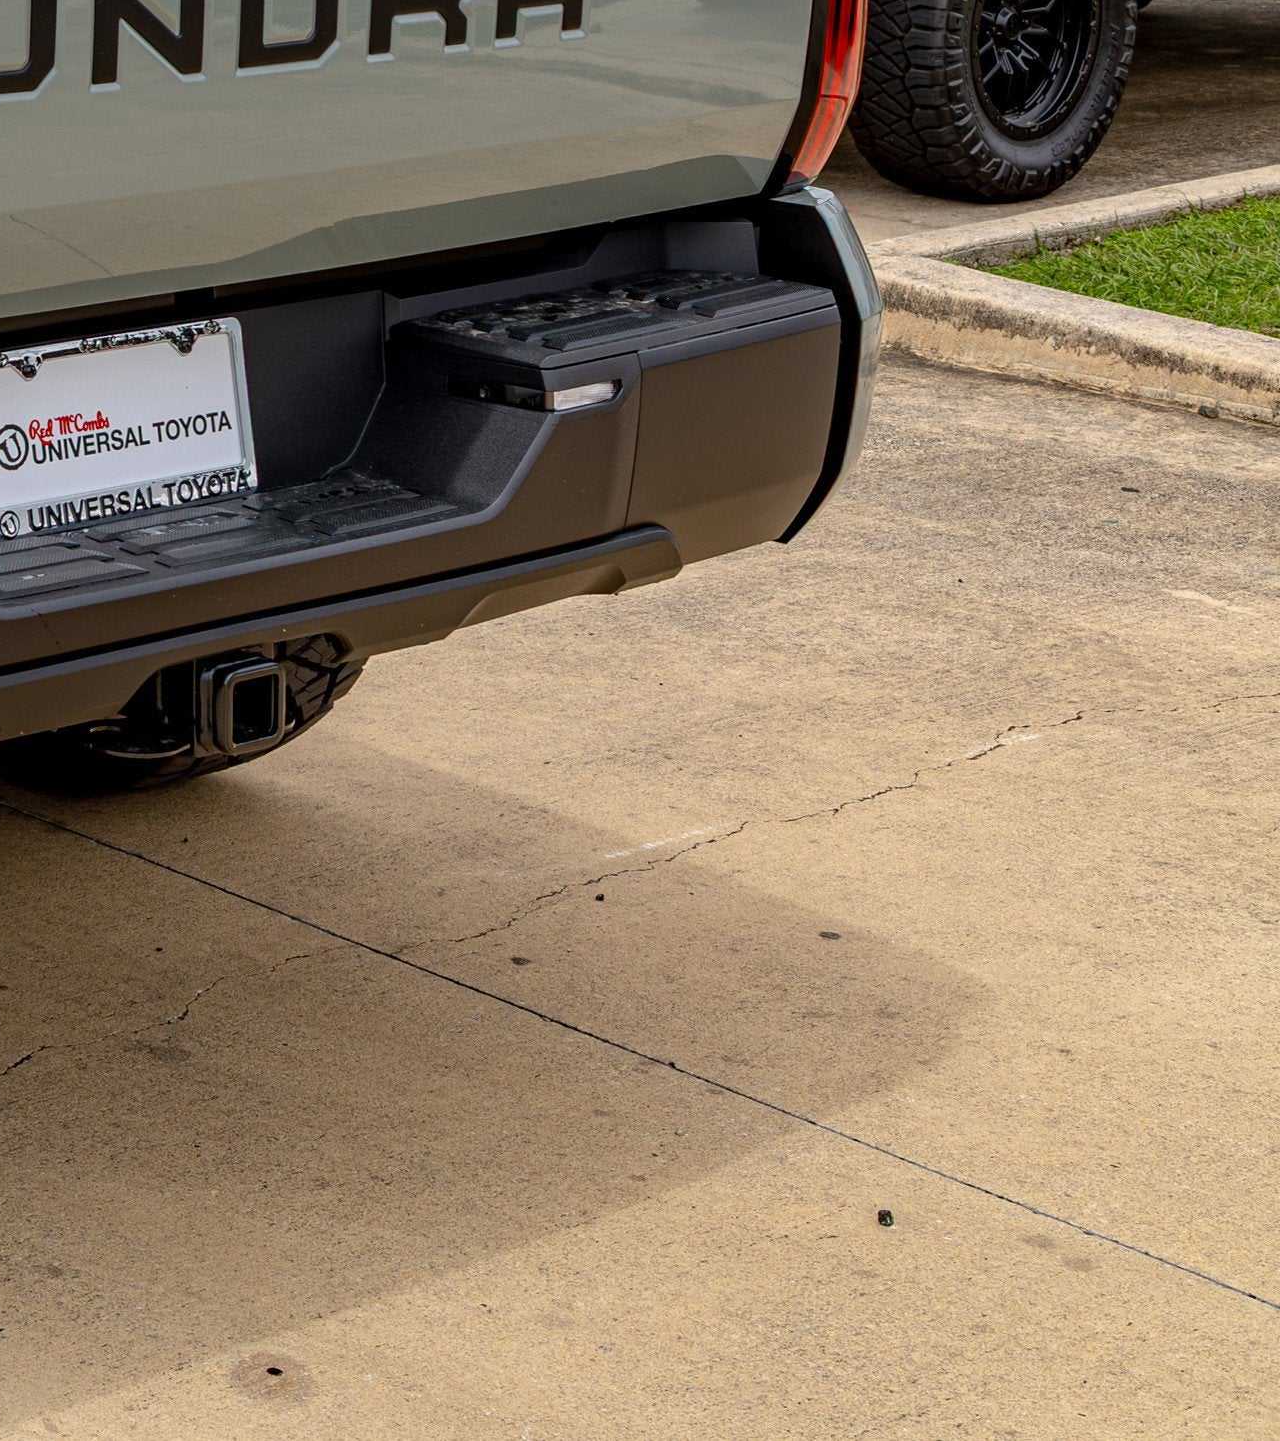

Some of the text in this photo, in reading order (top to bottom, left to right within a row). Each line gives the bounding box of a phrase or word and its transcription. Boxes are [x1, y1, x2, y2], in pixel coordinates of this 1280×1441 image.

[31, 425, 151, 465] UNIVERSAL
[152, 411, 233, 443] TOYOTA
[27, 486, 161, 533] UNIVERSAL
[162, 469, 251, 506] TOYOTA
